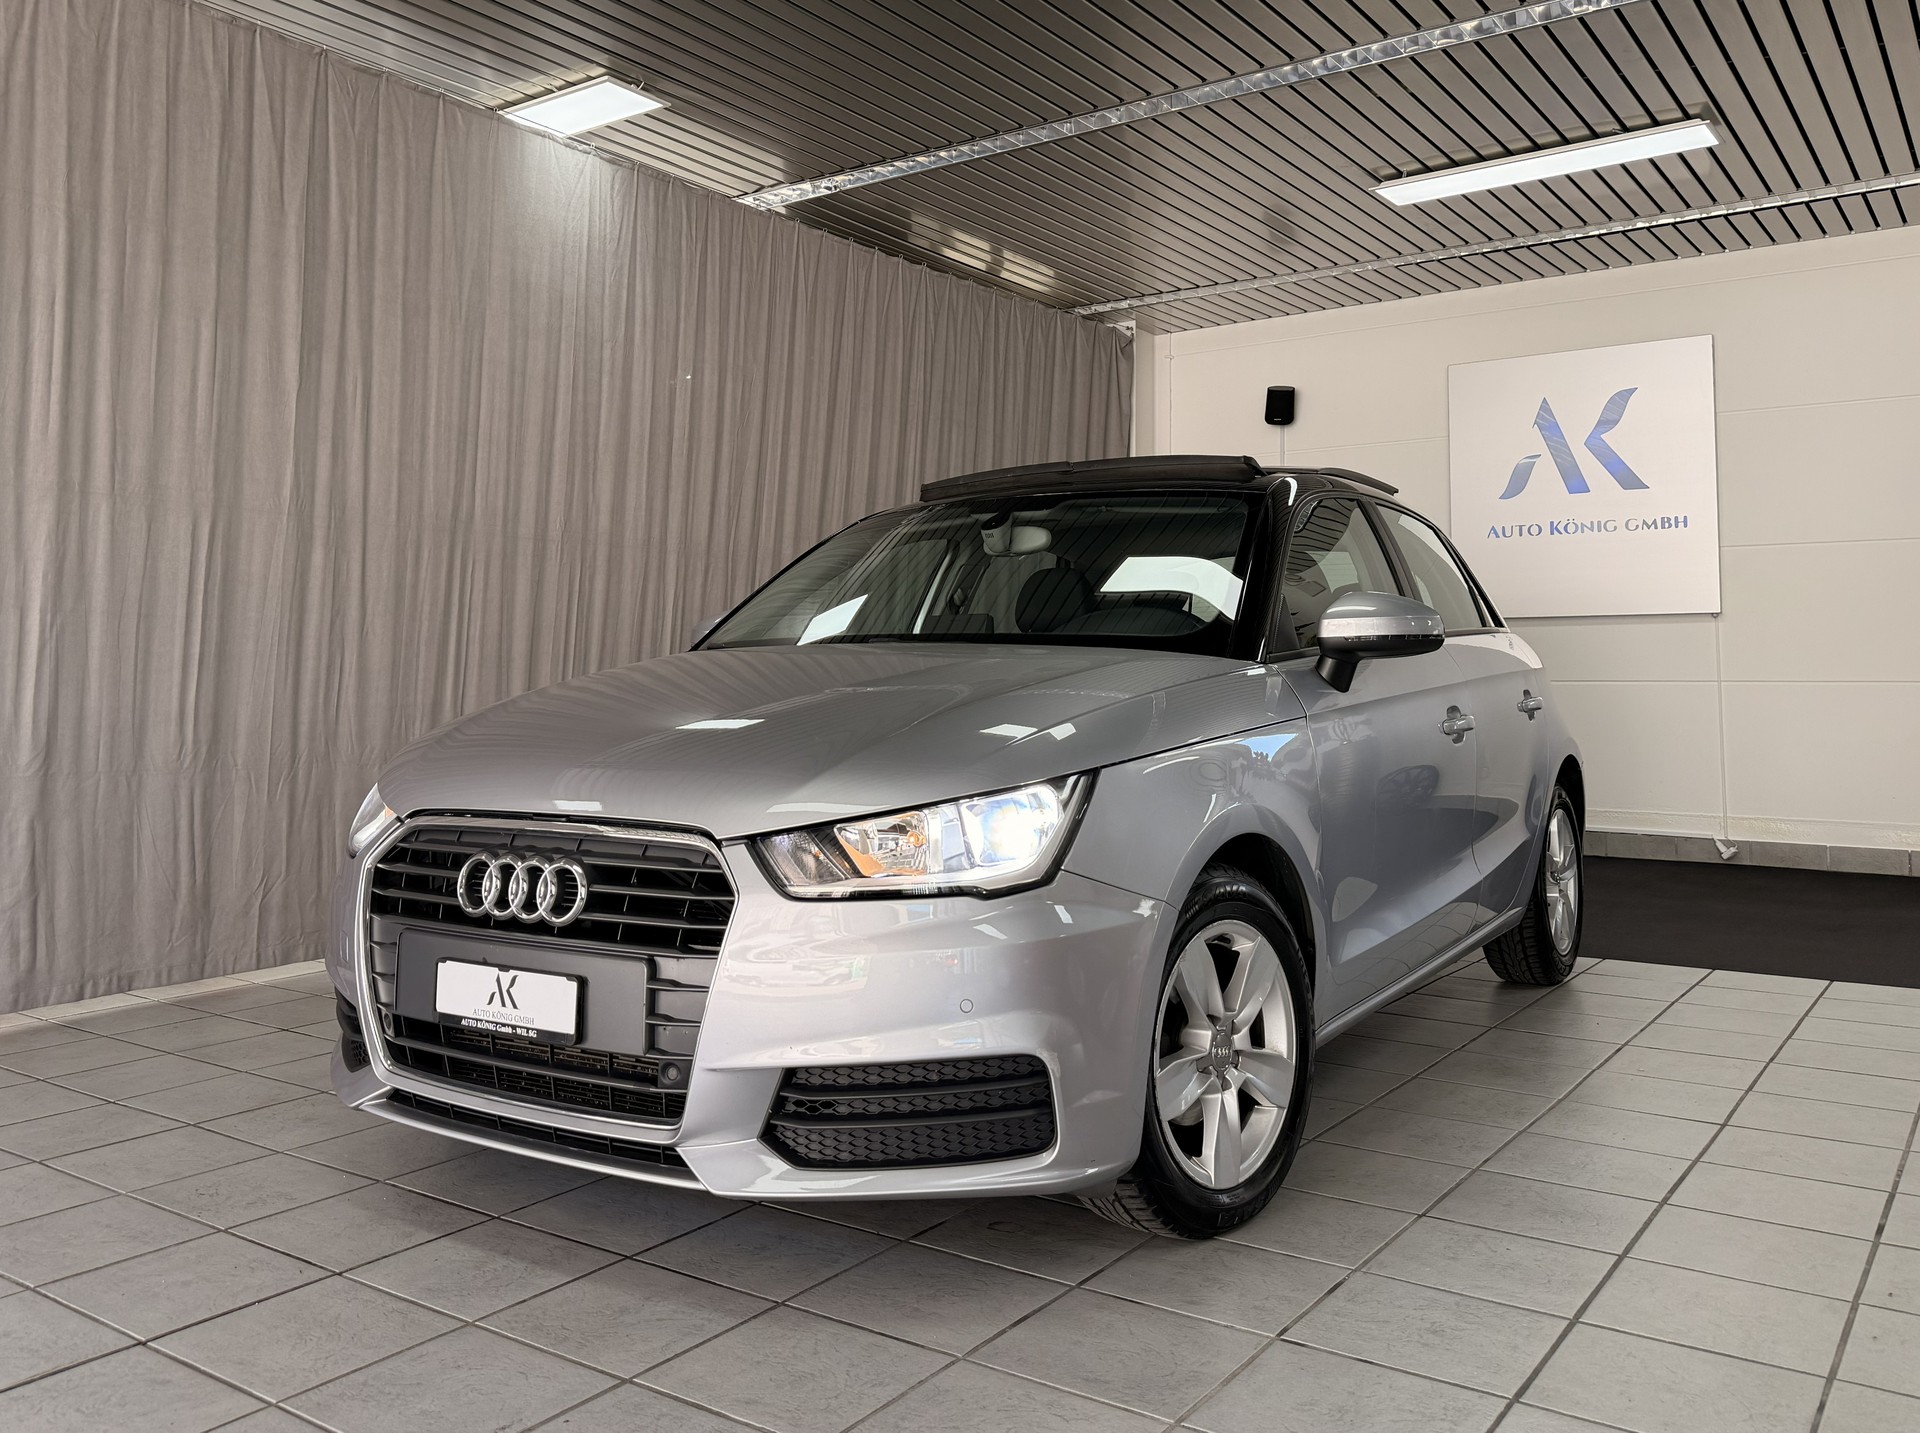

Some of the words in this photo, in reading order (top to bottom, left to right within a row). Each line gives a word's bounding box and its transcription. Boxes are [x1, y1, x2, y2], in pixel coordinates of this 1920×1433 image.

[1498, 387, 1650, 500] AK
[1487, 523, 1543, 539] AUTO
[1550, 518, 1618, 536] KÖNIG
[1625, 515, 1689, 532] GMBH
[486, 972, 520, 1010] AK
[461, 1018, 476, 1027] AUTO
[477, 1020, 497, 1030] KÖNIG
[472, 1008, 491, 1018] AUTO
[491, 1011, 513, 1022] KÖNIG
[514, 1014, 535, 1025] GMBH
